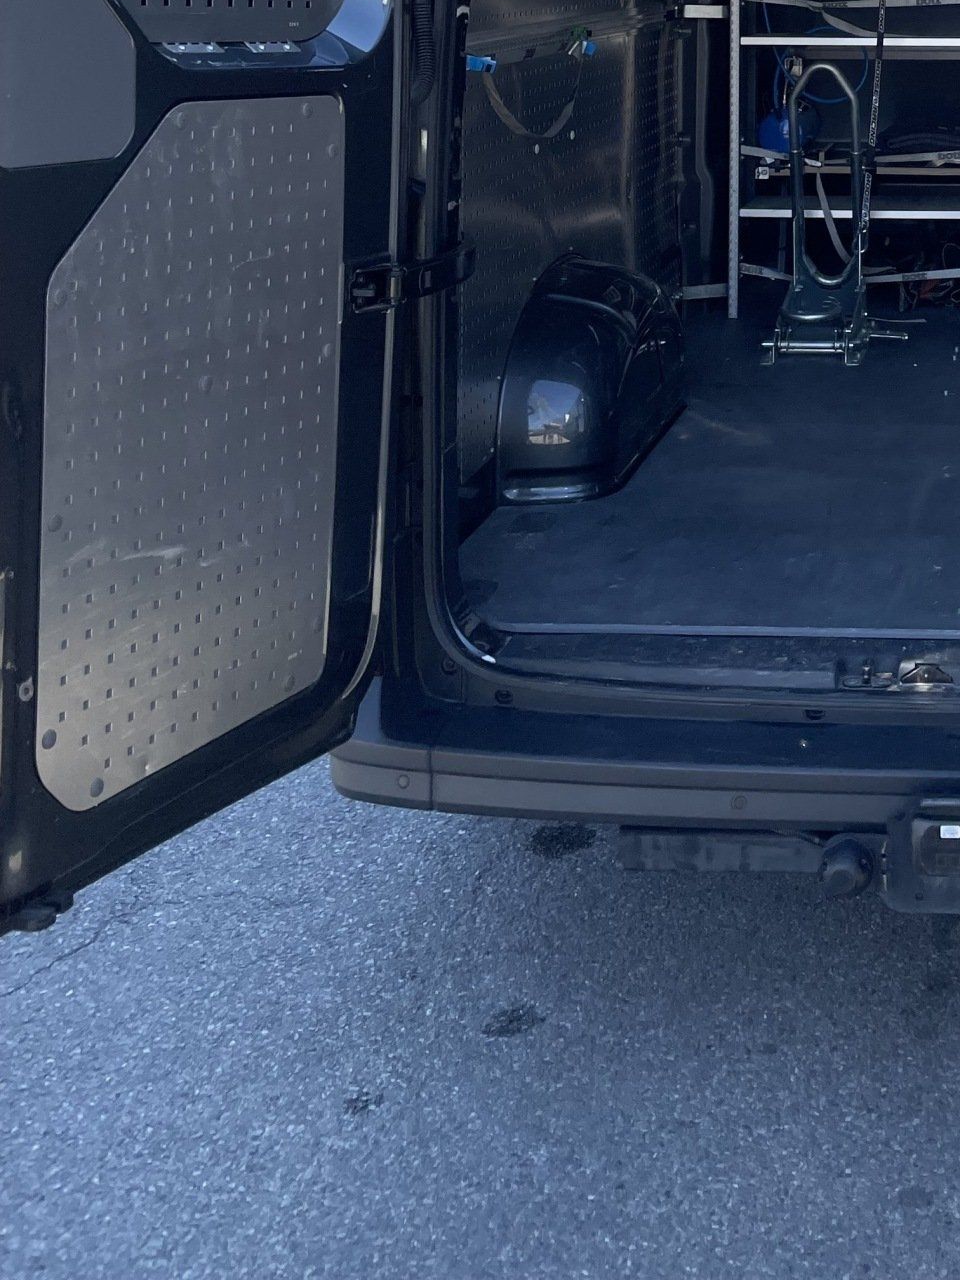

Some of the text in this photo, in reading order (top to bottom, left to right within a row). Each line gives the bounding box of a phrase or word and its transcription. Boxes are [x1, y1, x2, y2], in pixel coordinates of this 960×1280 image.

[868, 58, 882, 147] MOOSE RACING
[862, 172, 873, 210] MOOSE
